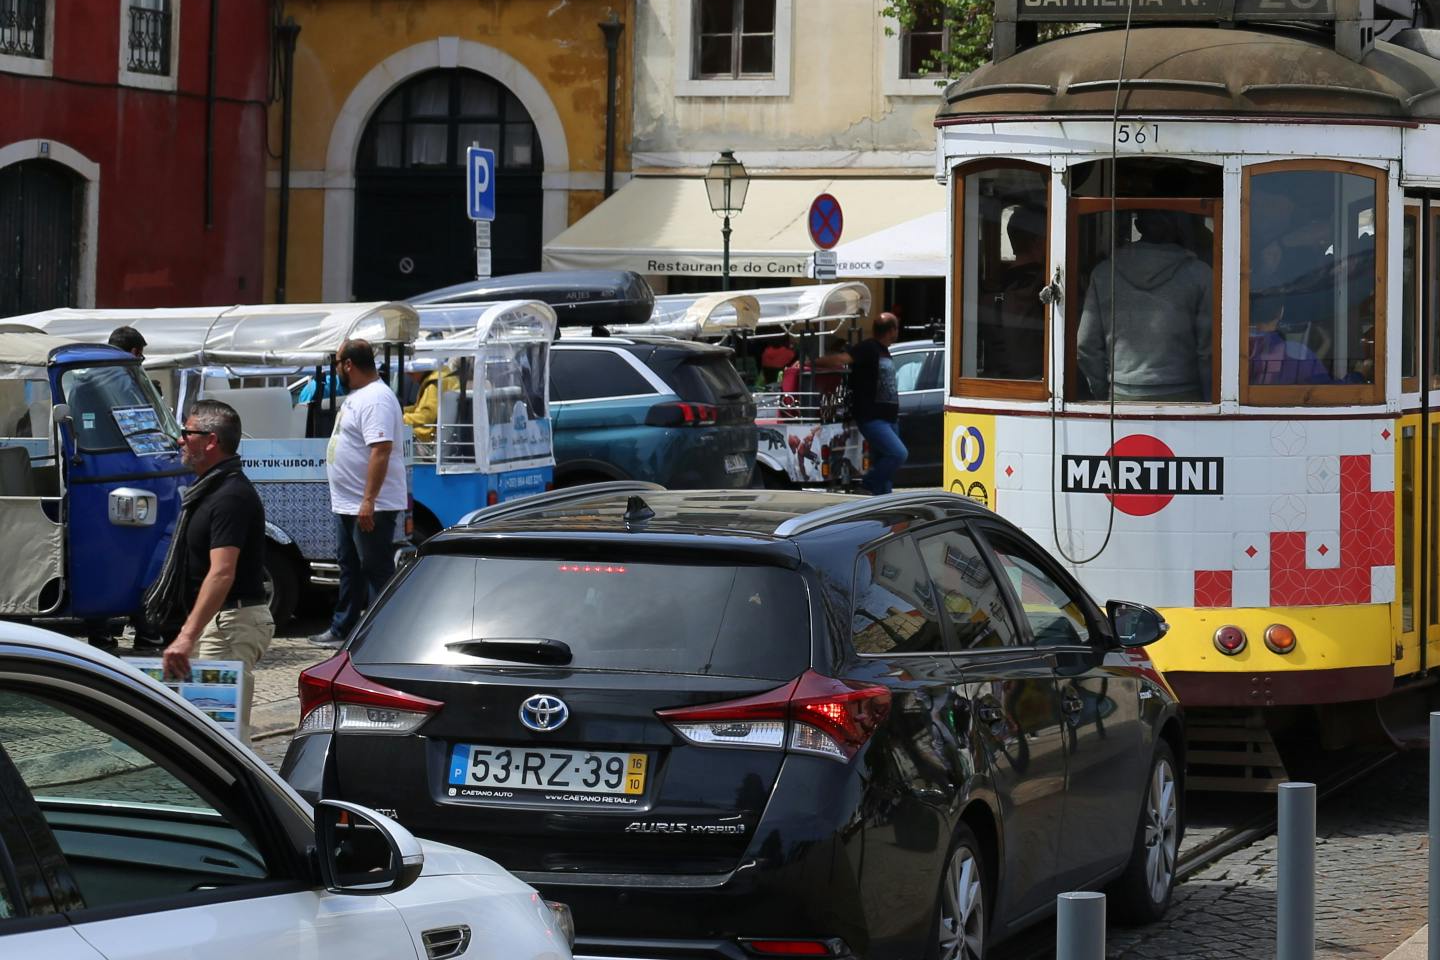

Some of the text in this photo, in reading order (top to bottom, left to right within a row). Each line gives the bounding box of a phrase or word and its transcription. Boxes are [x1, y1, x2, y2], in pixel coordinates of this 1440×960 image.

[1118, 124, 1158, 143] 561
[474, 156, 489, 212] P
[647, 259, 738, 272] Restaurane
[743, 261, 762, 273] do
[849, 262, 871, 271] BOCK
[1067, 459, 1217, 491] MARTINI
[454, 768, 462, 778] P
[632, 757, 642, 769] 16
[629, 778, 640, 790] 10
[461, 789, 492, 797] CAETANO
[625, 822, 736, 834] AURIS HYBRID
